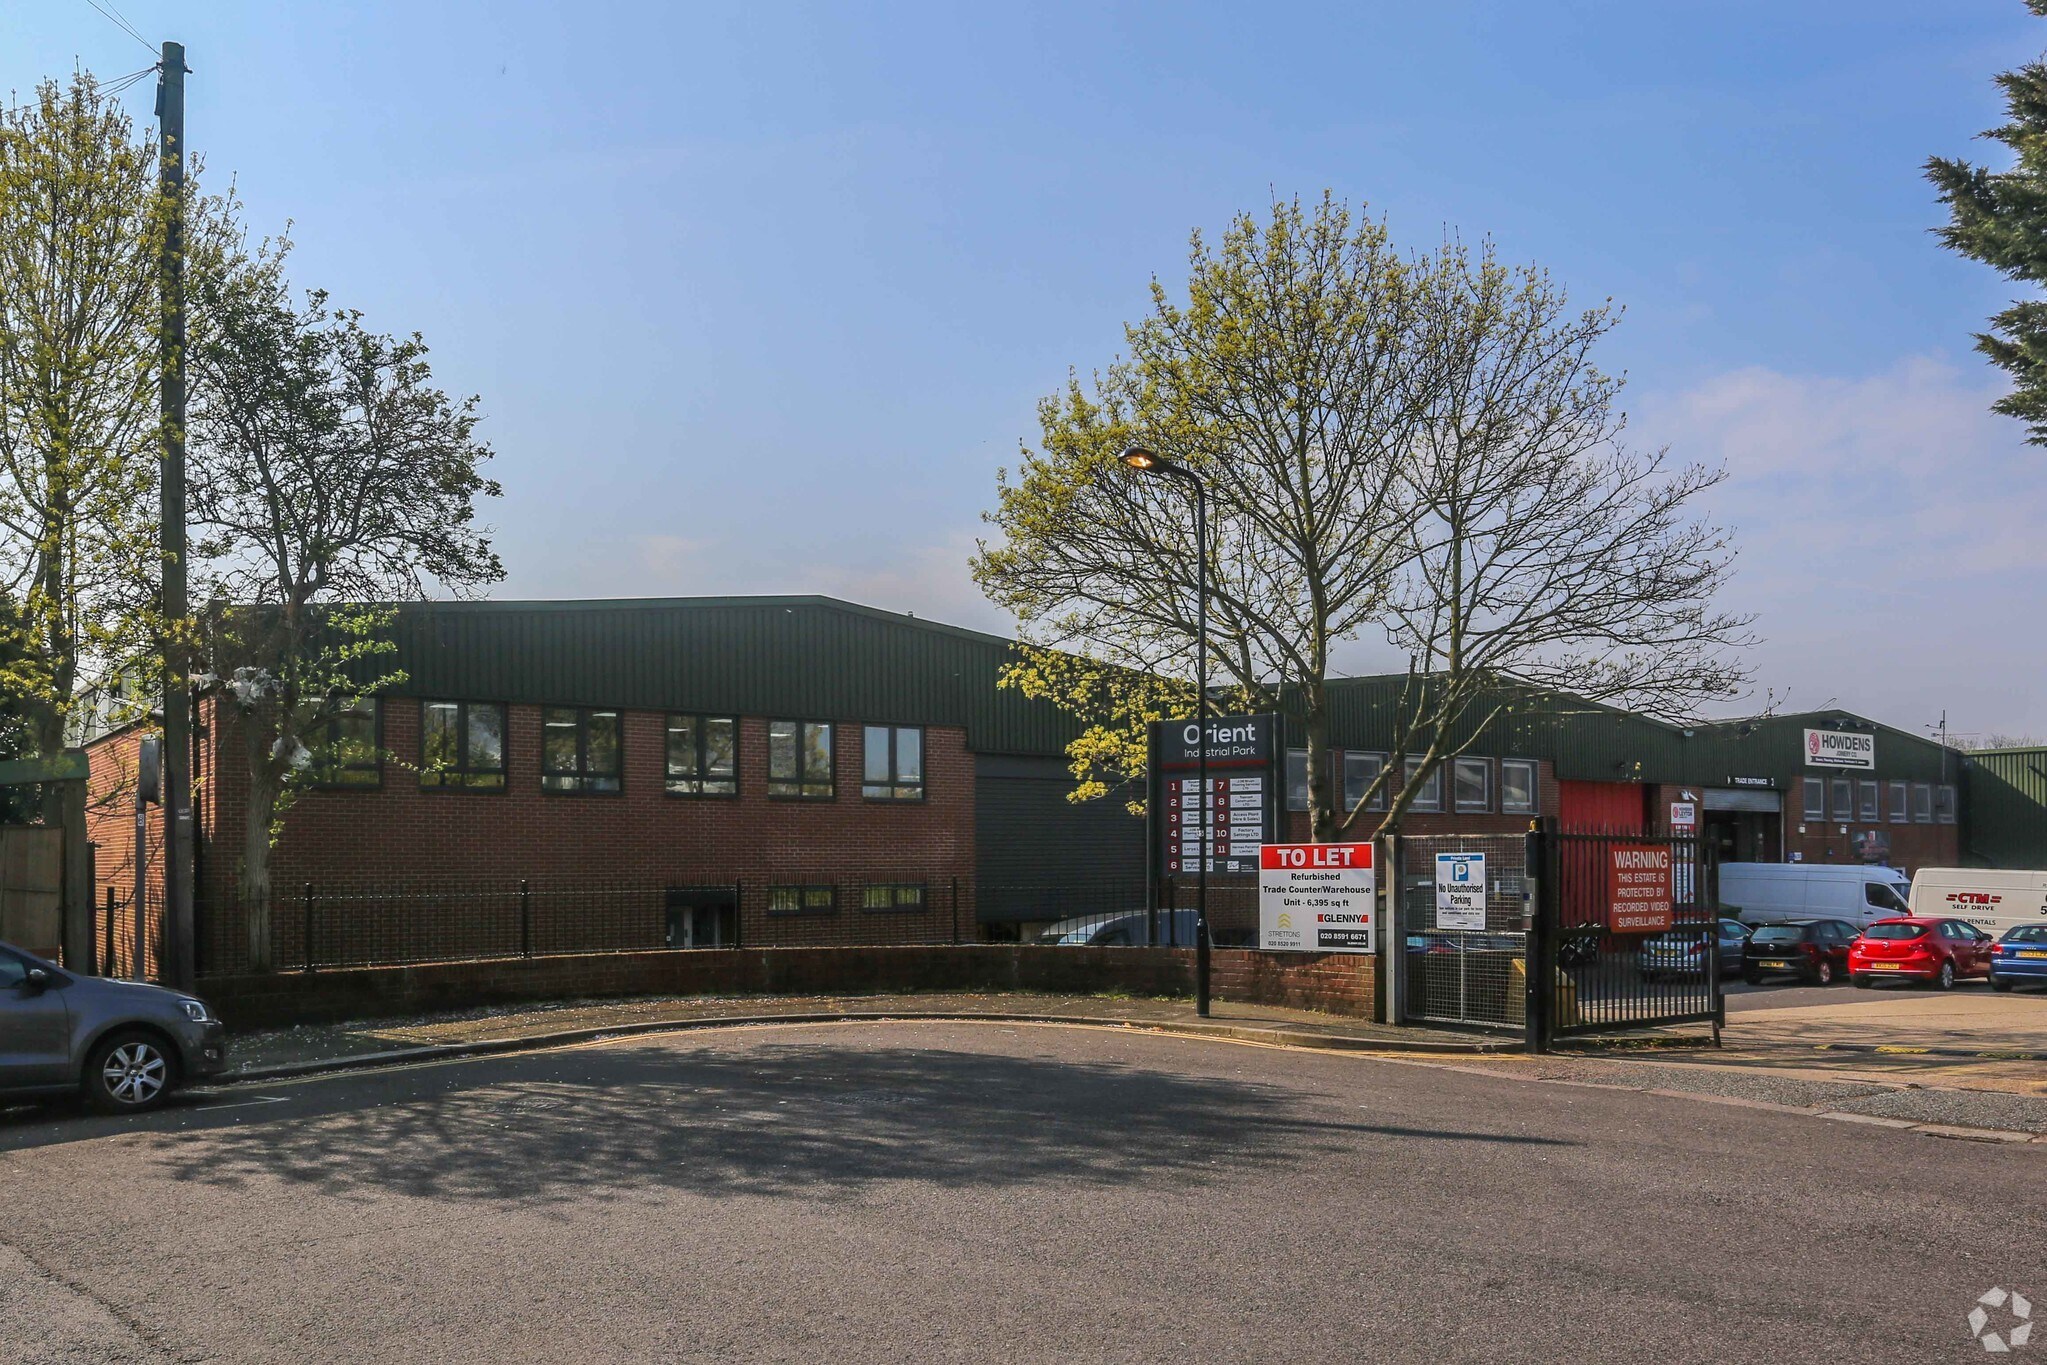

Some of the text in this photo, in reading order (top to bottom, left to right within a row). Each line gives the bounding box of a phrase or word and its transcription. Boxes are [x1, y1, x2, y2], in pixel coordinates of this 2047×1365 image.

[1184, 724, 1256, 744] Orient
[1822, 734, 1870, 751] HOWDENS
[1184, 746, 1256, 758] Indstrial Park
[1277, 848, 1354, 866] TO LET
[1614, 851, 1668, 869] WARNING
[1455, 865, 1466, 880] P
[1618, 873, 1665, 883] THIS ESTATE IS
[1439, 884, 1483, 893] No Unauthorised
[1618, 888, 1664, 897] PROTECTED BY
[1451, 895, 1471, 906] Parking
[1958, 893, 1989, 904] CTM
[1613, 902, 1669, 912] RECORDED VIDEO
[1324, 914, 1362, 922] GLENNY
[1618, 916, 1664, 927] SURVEILLANCE
